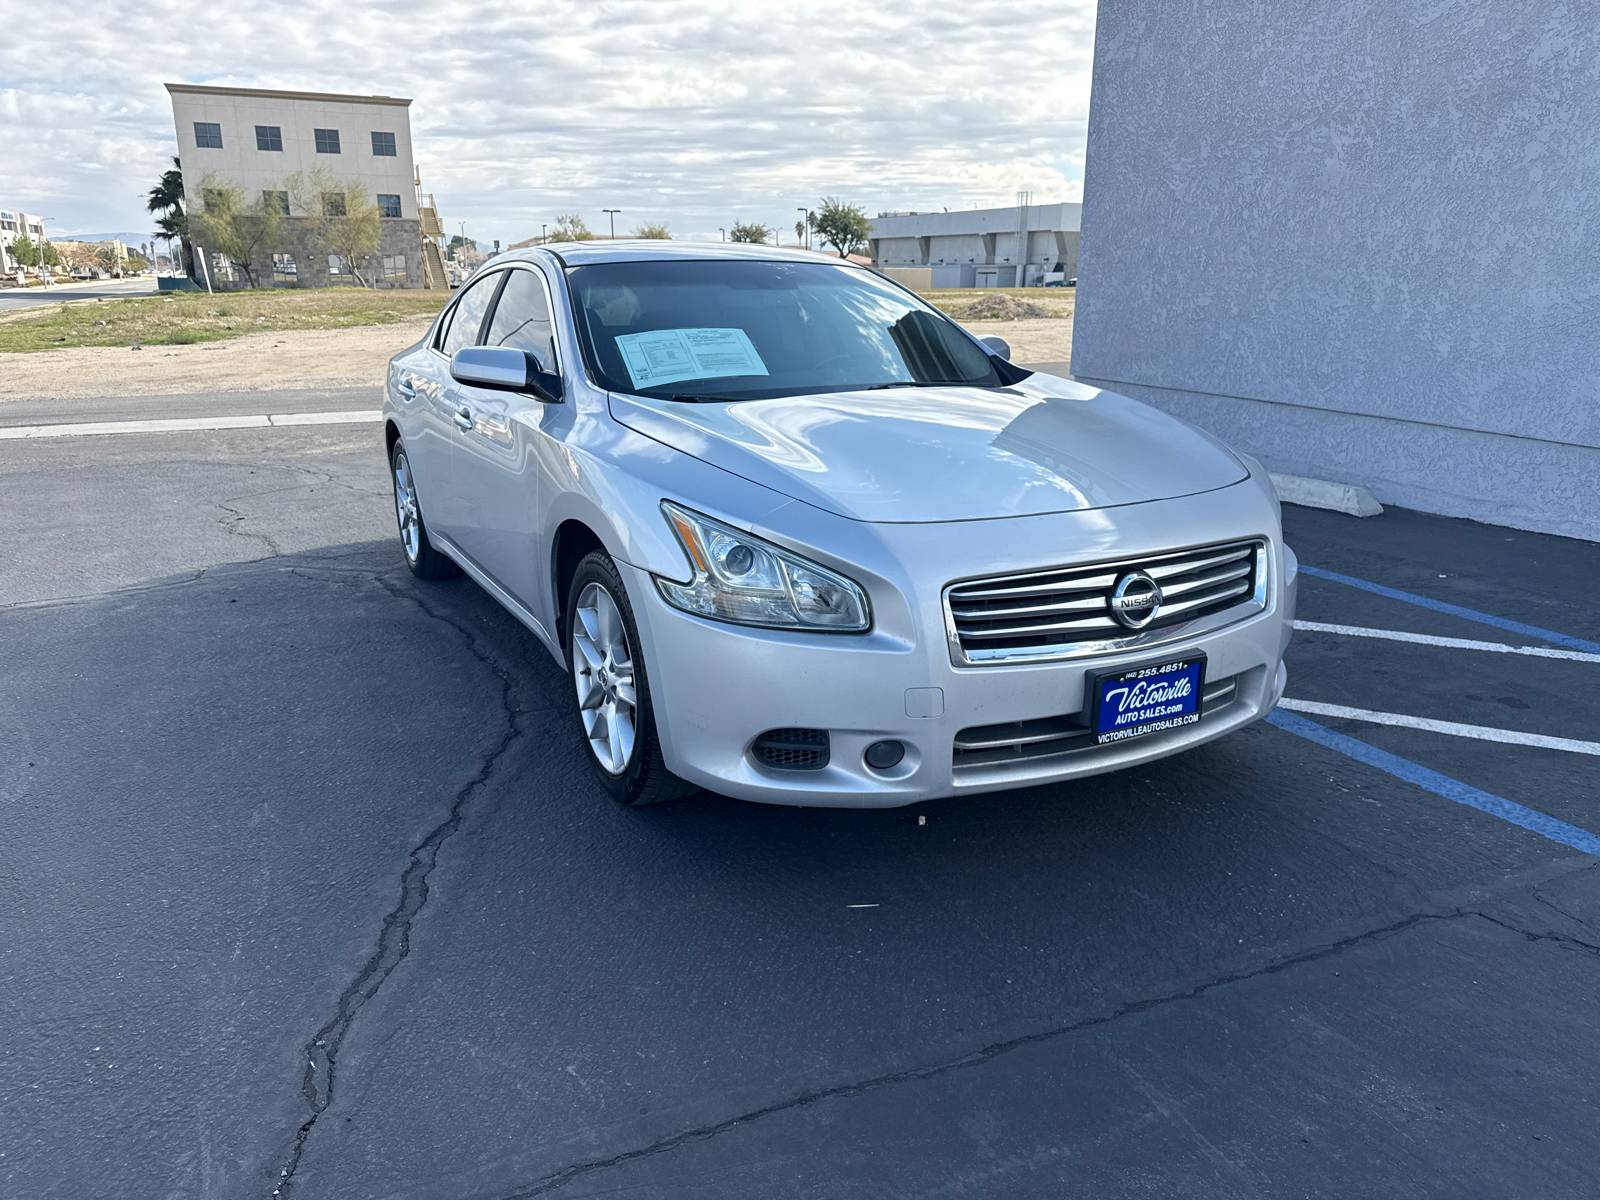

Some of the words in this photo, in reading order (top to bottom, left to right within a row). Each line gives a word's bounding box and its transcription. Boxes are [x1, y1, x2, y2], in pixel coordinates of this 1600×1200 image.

[1120, 594, 1160, 608] NISSAN
[1138, 662, 1183, 679] 255.4851
[1105, 677, 1192, 712] Victorville
[1115, 711, 1138, 725] AUTO
[1139, 704, 1183, 720] SALES.com
[1098, 713, 1199, 744] VICTORVILLEAUTOSALES.COM
